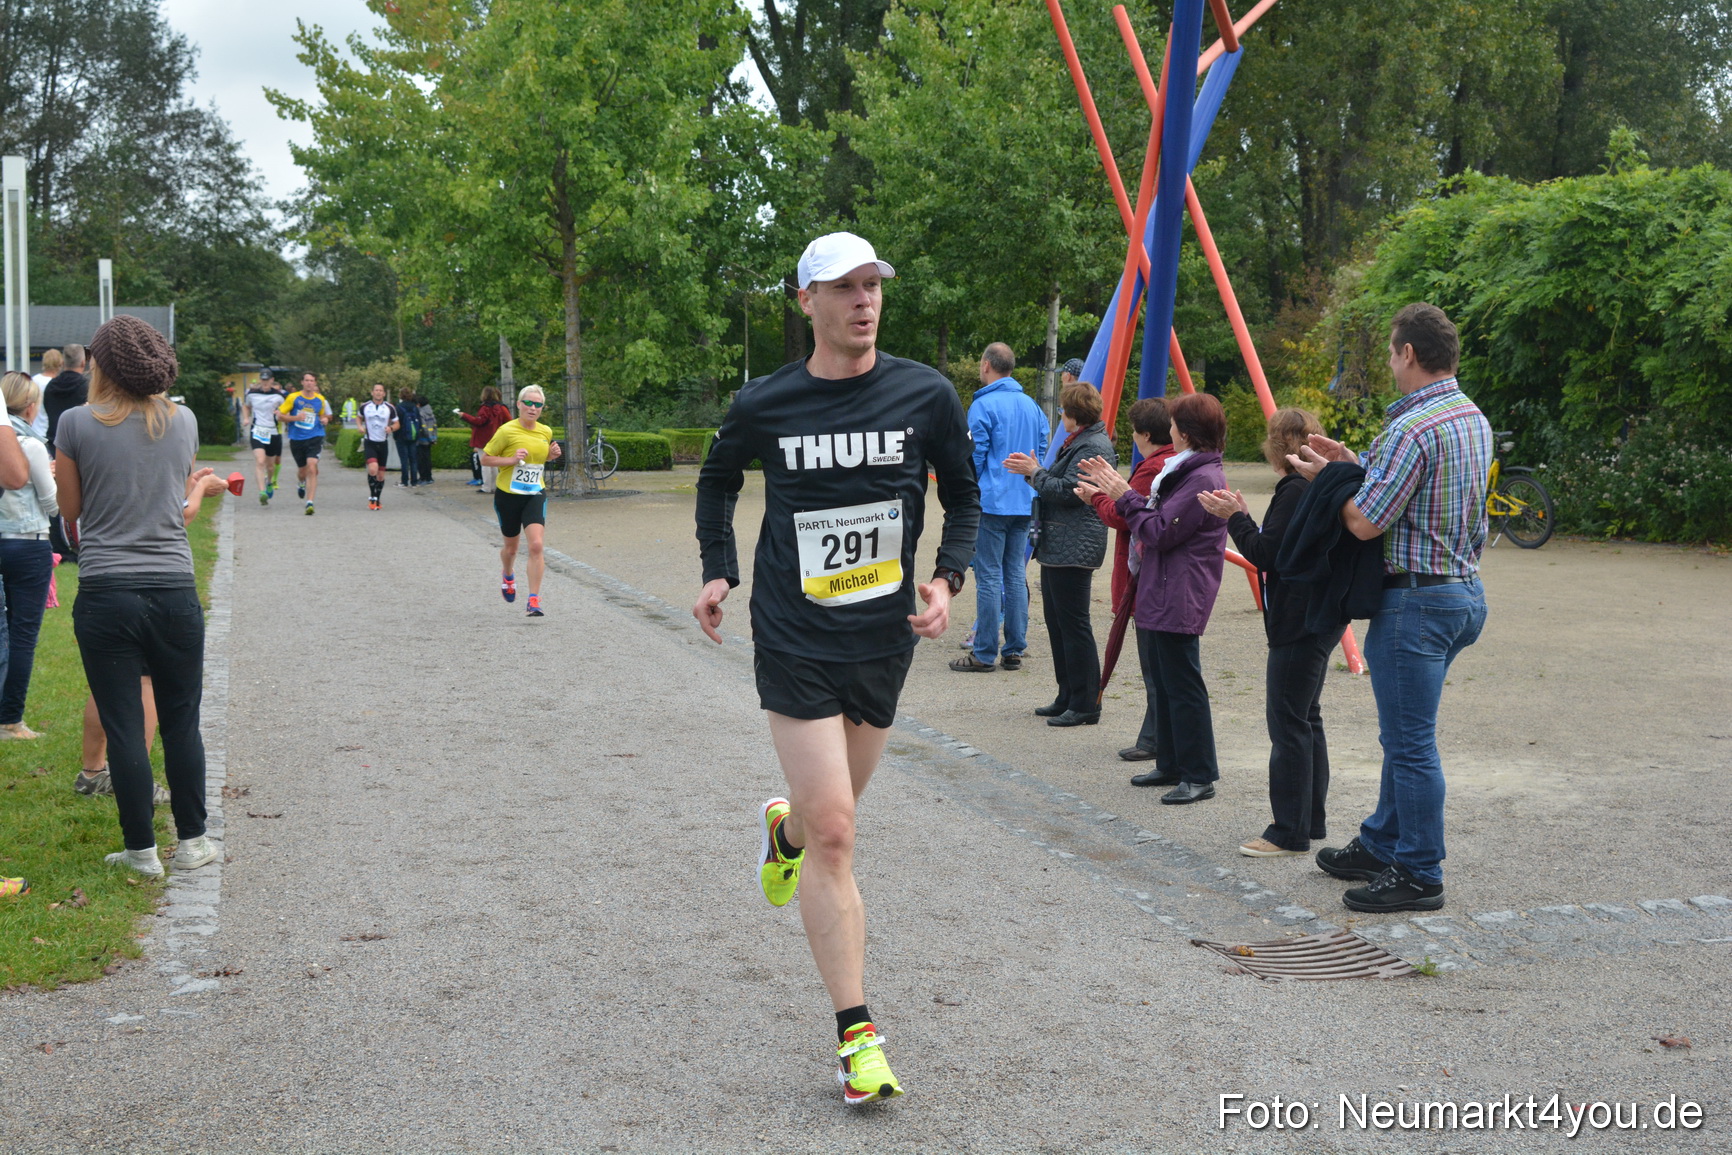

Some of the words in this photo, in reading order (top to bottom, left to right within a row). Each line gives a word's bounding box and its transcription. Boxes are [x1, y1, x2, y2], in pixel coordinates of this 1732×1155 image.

[778, 431, 905, 470] THULE
[515, 470, 539, 483] 2321
[798, 520, 833, 533] PARTL
[836, 514, 885, 528] Neumarkt
[822, 527, 879, 571] 291
[829, 569, 880, 594] Michael
